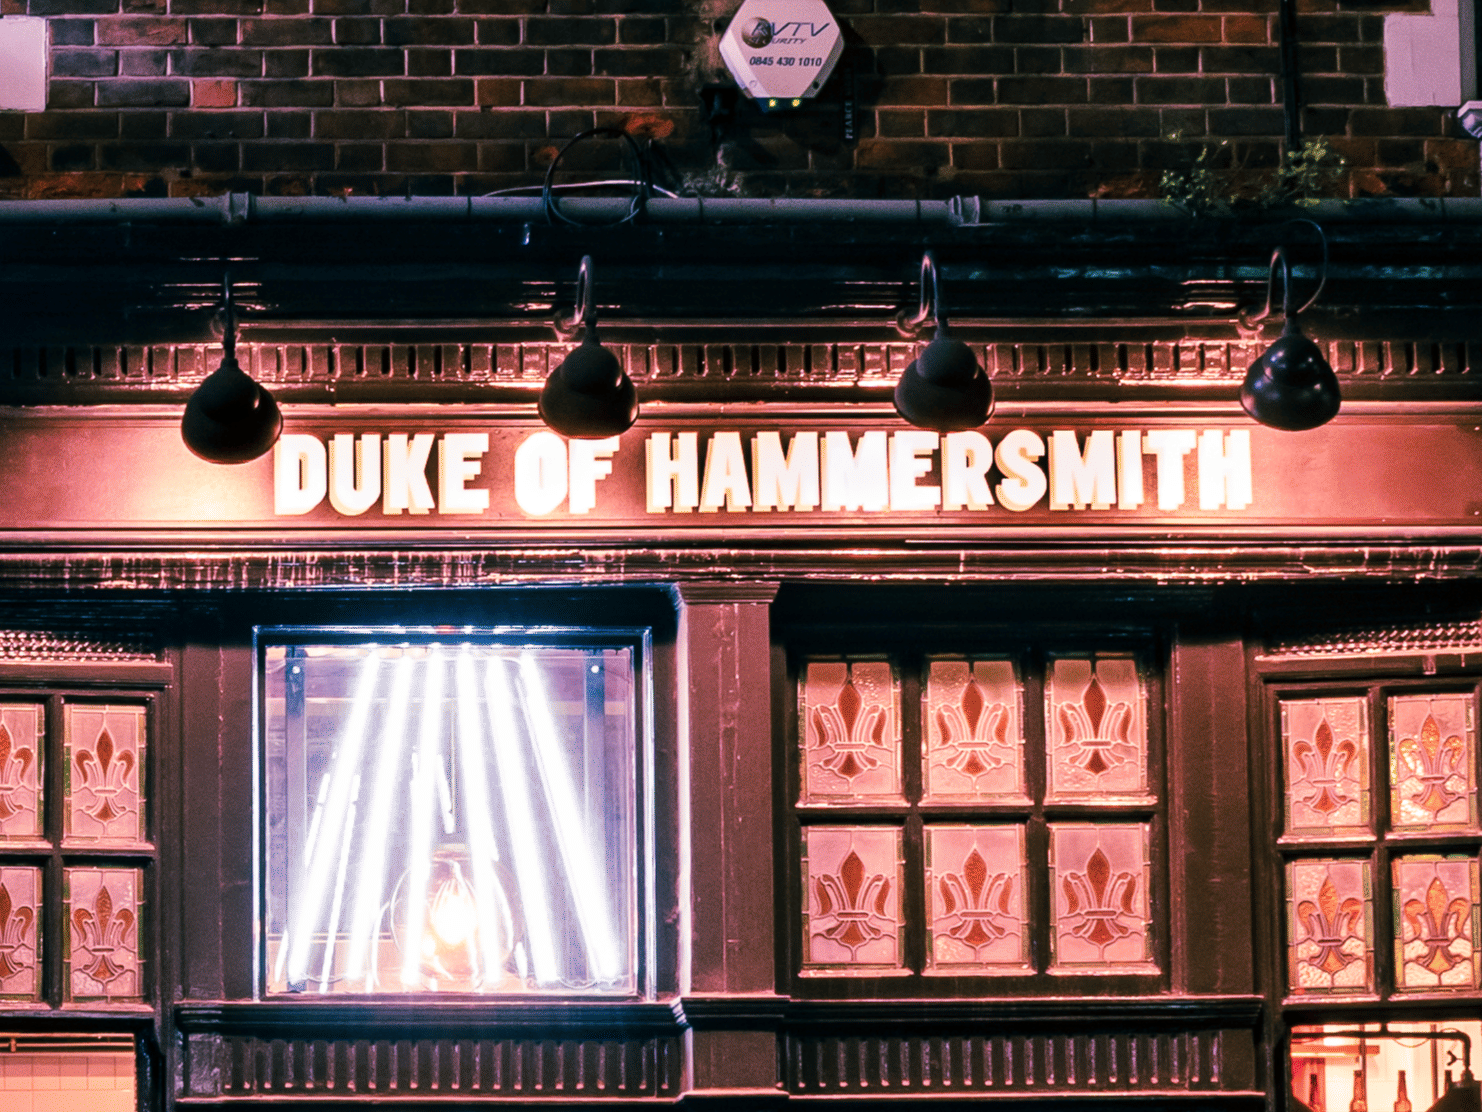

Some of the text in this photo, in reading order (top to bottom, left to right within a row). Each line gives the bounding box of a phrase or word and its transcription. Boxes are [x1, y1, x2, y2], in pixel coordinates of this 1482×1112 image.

[749, 56, 823, 67] 0845 430 1010
[274, 430, 1253, 516] DUKE OF HAMMERSMITH
